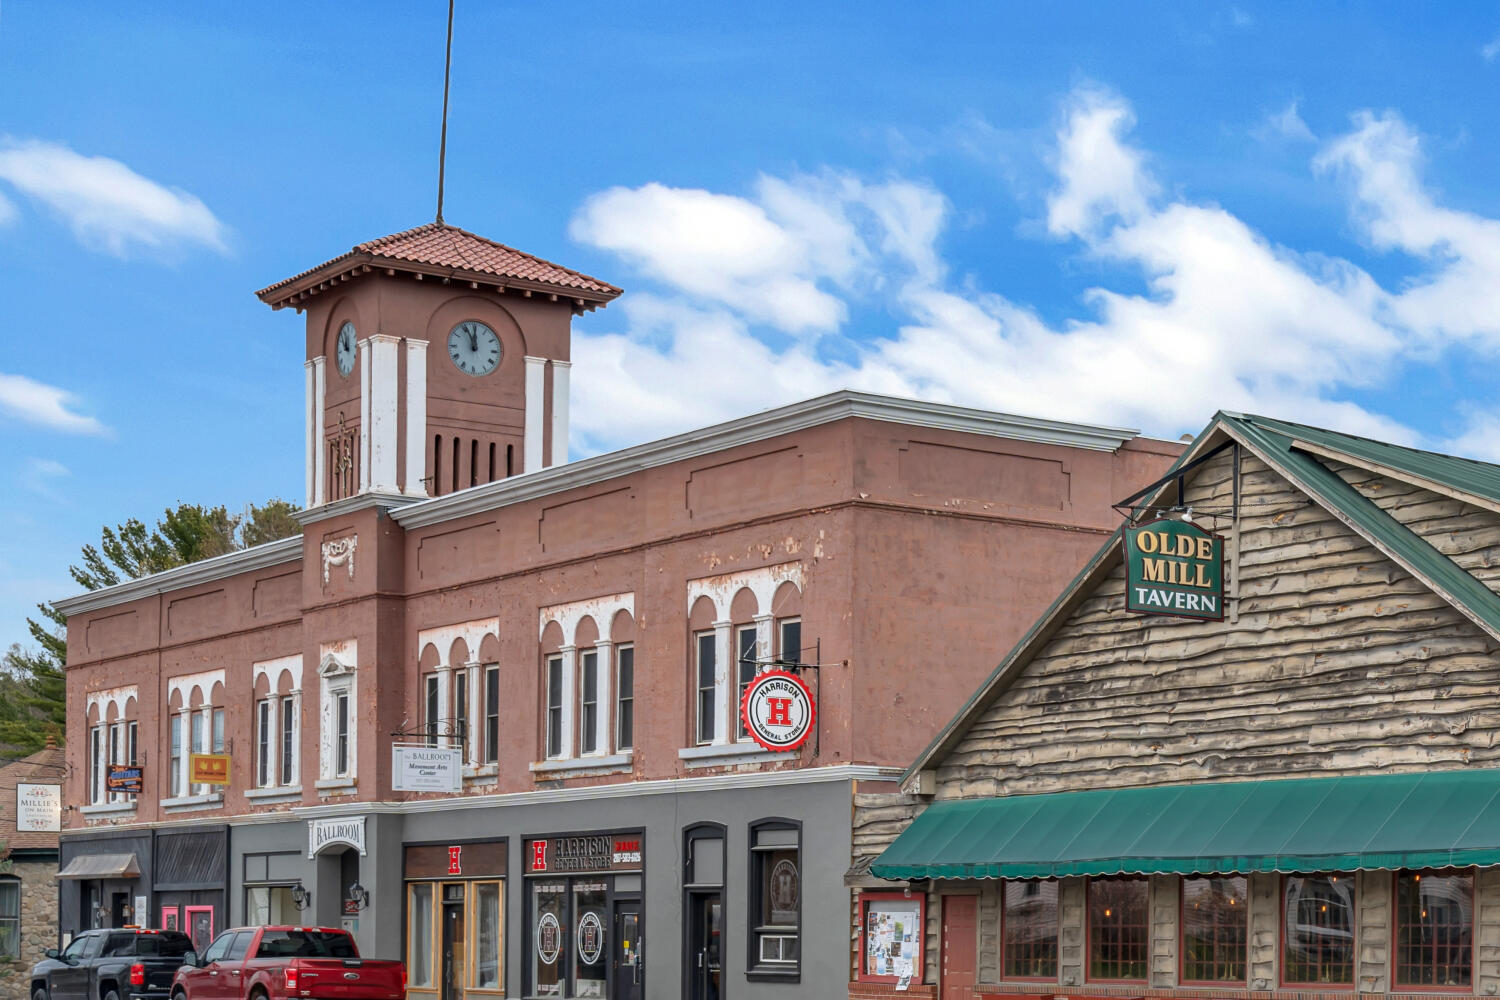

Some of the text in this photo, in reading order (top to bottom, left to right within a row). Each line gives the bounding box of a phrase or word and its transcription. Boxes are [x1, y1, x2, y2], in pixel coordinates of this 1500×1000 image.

[1136, 530, 1213, 561] OLDE
[1141, 557, 1211, 588] MILL
[1135, 587, 1216, 612] TAVERN
[759, 682, 800, 698] HARRISON
[766, 696, 793, 727] H
[759, 723, 801, 740] GENERAL STORE
[316, 823, 359, 846] BALLROOM
[555, 835, 611, 857] HARRISON
[448, 846, 461, 875] H
[532, 840, 547, 871] H
[555, 855, 611, 870] GENERAL STORE
